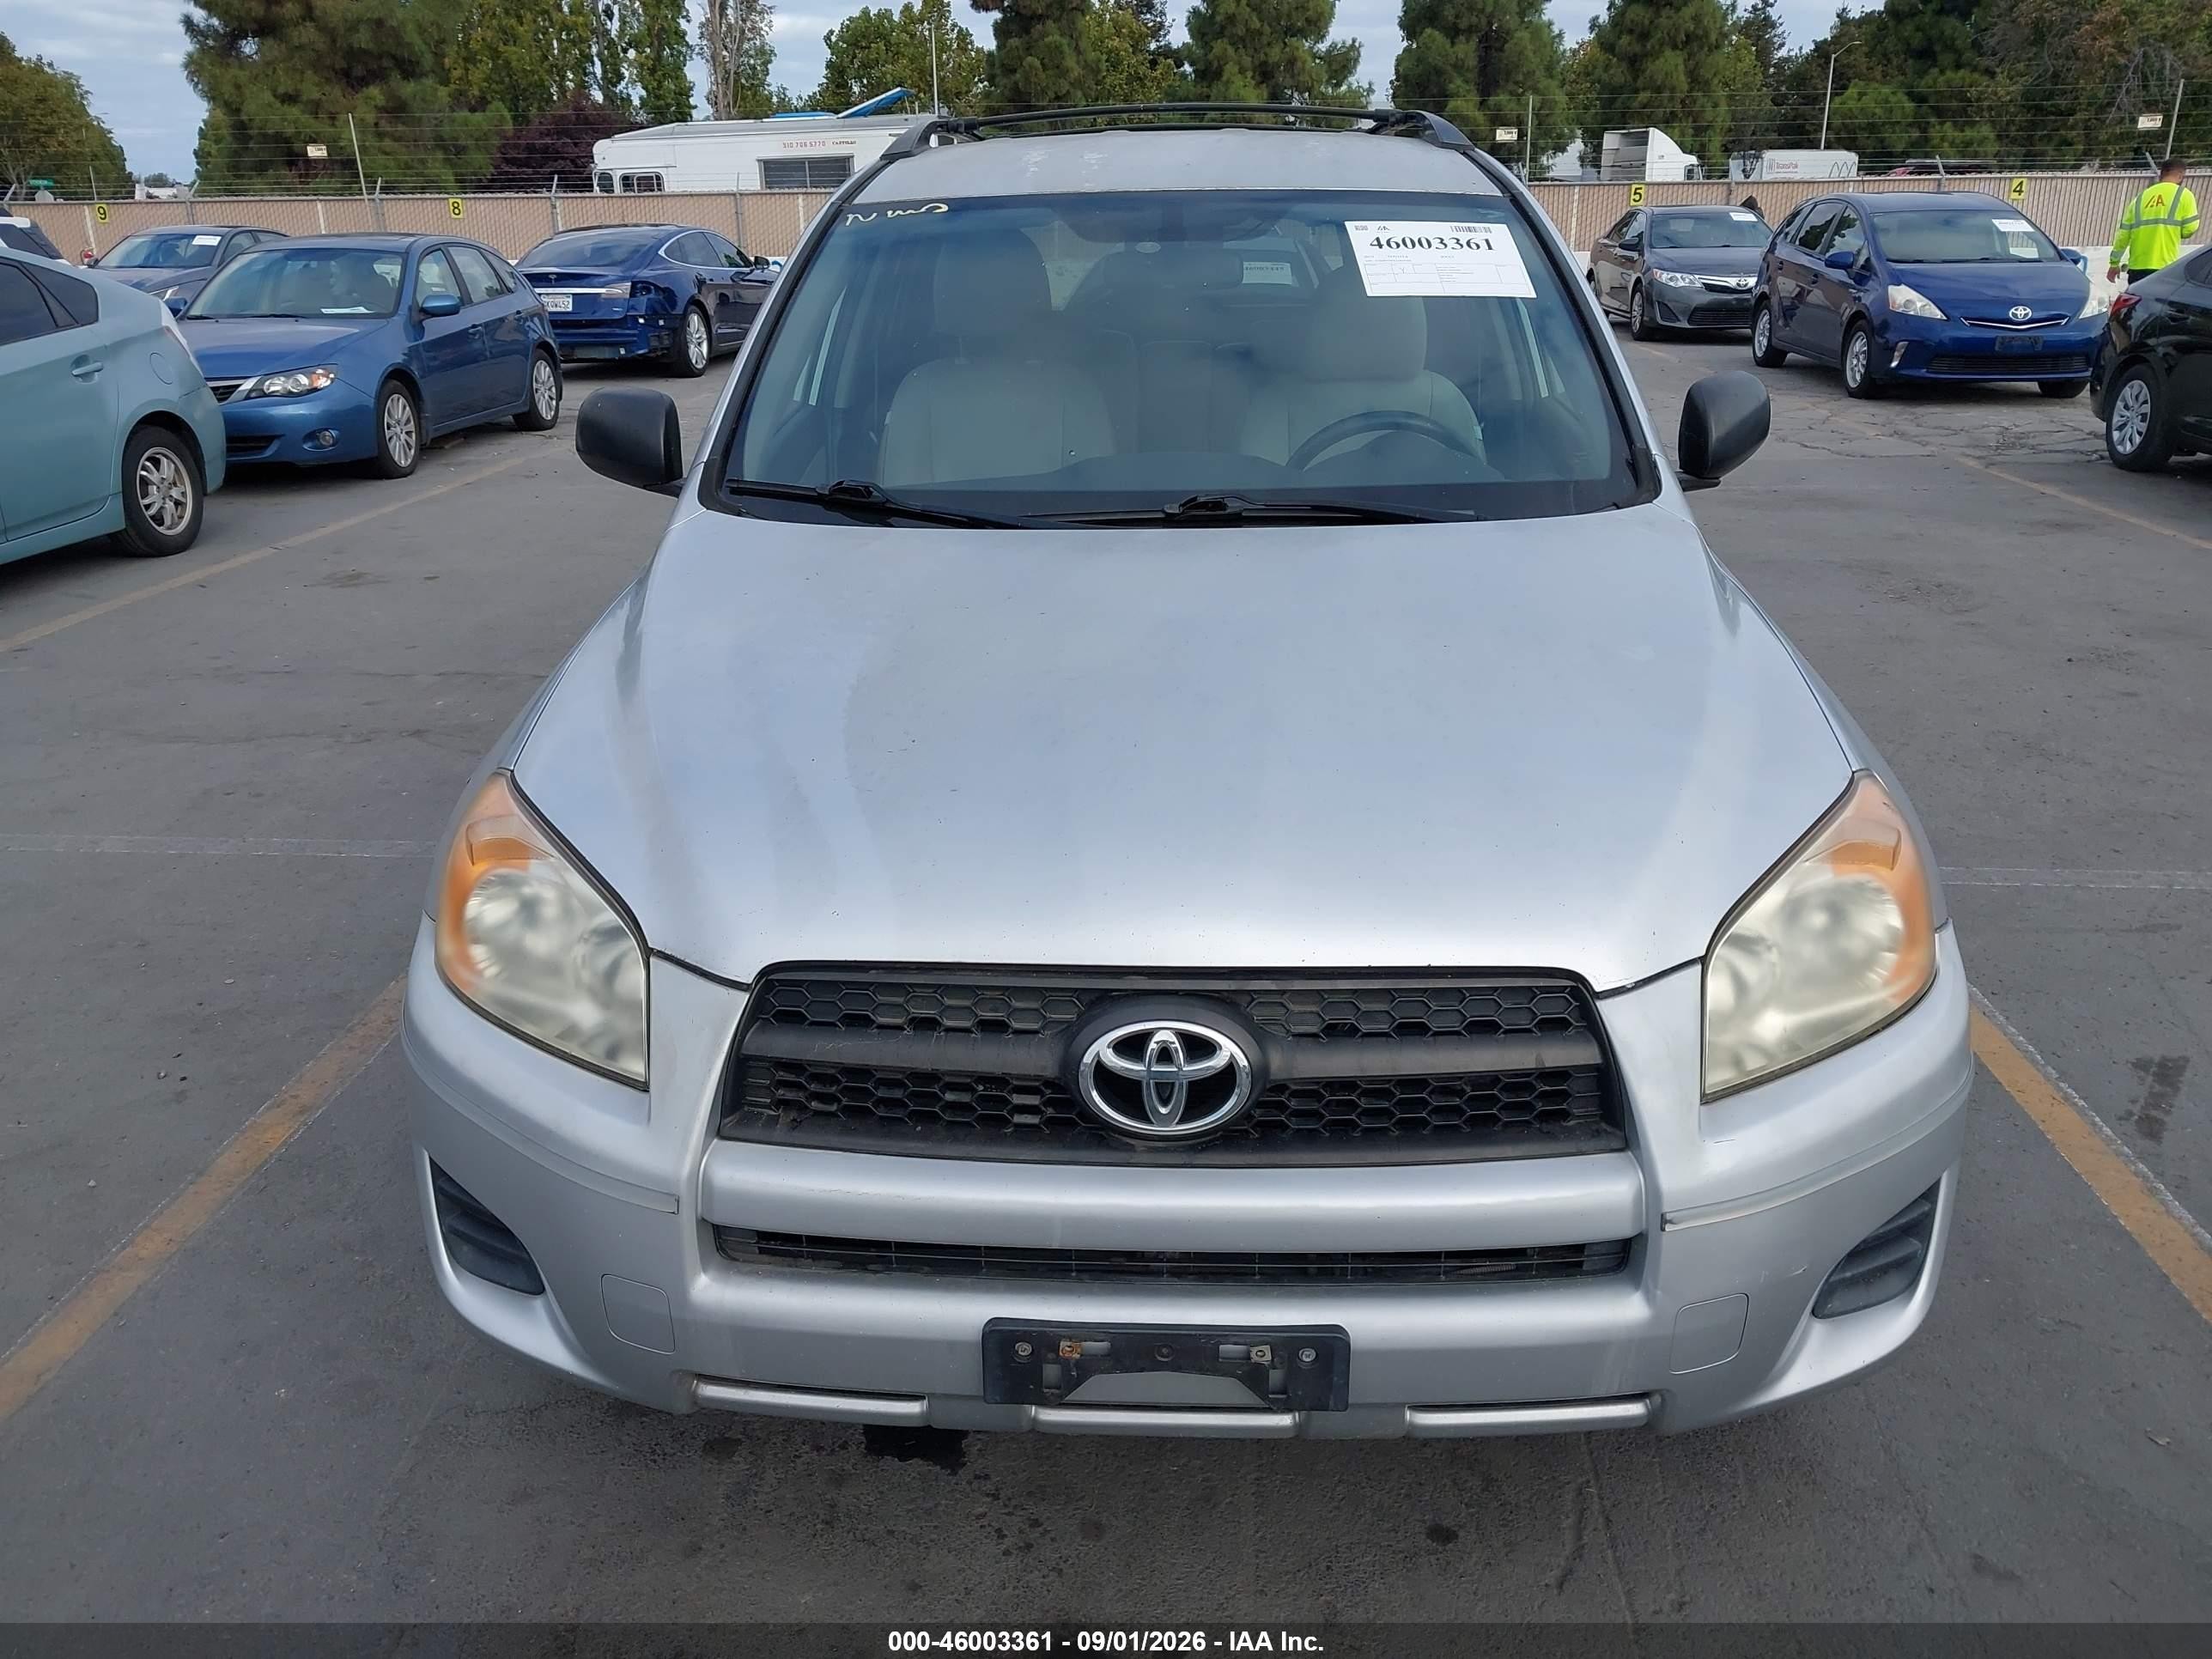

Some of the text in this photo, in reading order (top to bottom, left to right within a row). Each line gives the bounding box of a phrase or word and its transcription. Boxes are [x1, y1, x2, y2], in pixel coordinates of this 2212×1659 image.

[1632, 186, 1643, 203] 5
[2012, 179, 2024, 196] 4
[97, 206, 107, 221] 9
[452, 201, 461, 216] 8
[1369, 235, 1497, 252] 46003361
